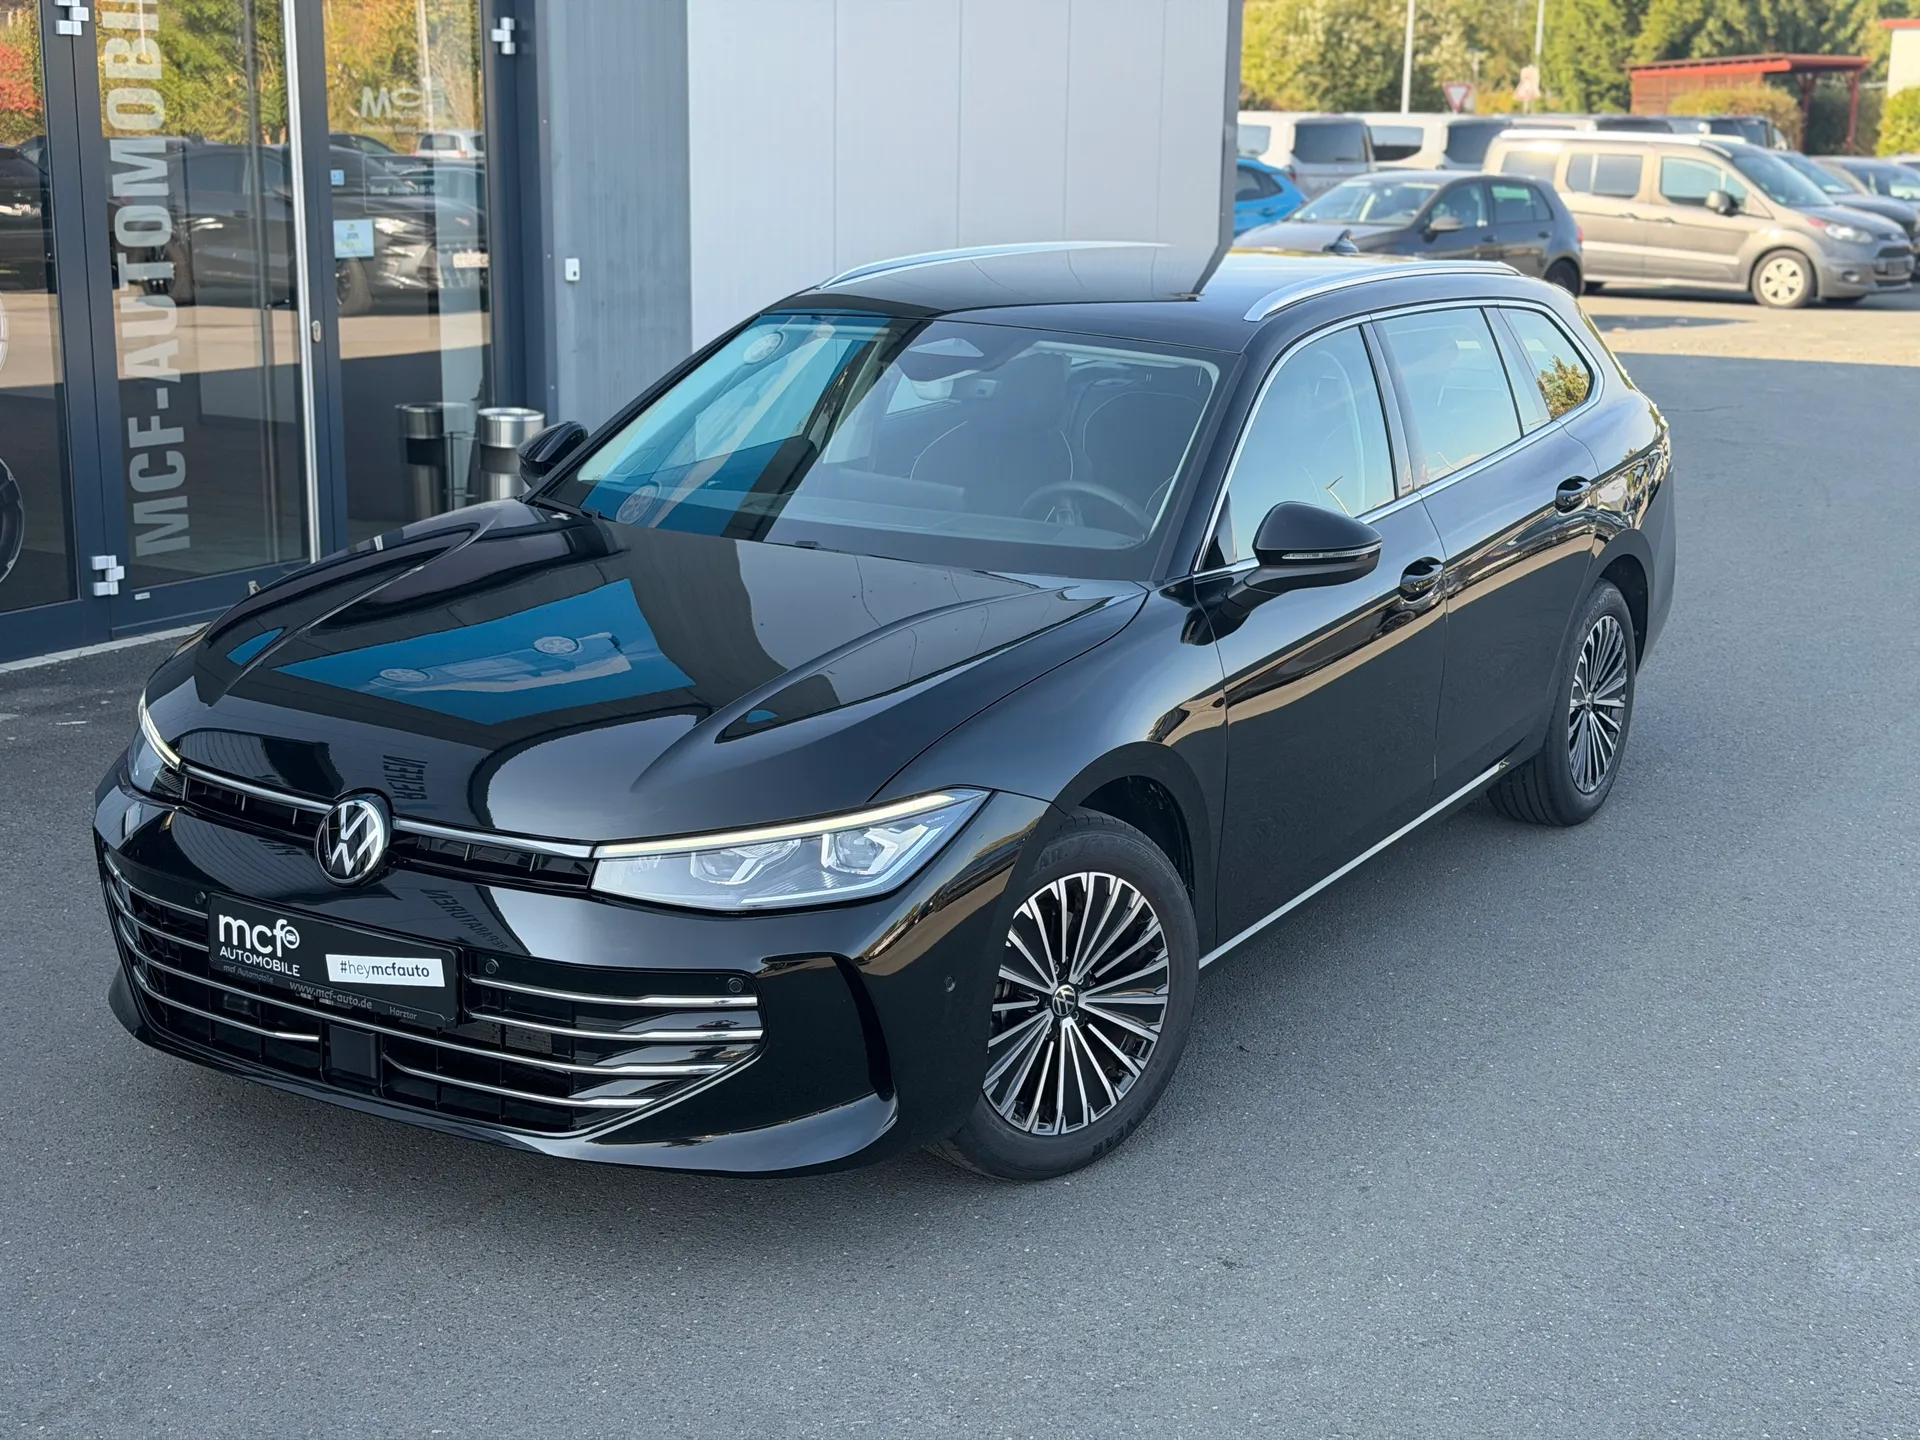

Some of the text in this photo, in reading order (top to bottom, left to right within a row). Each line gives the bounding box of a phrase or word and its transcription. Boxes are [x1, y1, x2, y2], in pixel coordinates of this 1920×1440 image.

[102, 0, 191, 557] MCF-AUTOMOBI
[220, 946, 300, 976] AUTOMOBILE
[340, 961, 430, 978] #heymcfauto
[289, 981, 373, 1010] www.mcf-auto.de
